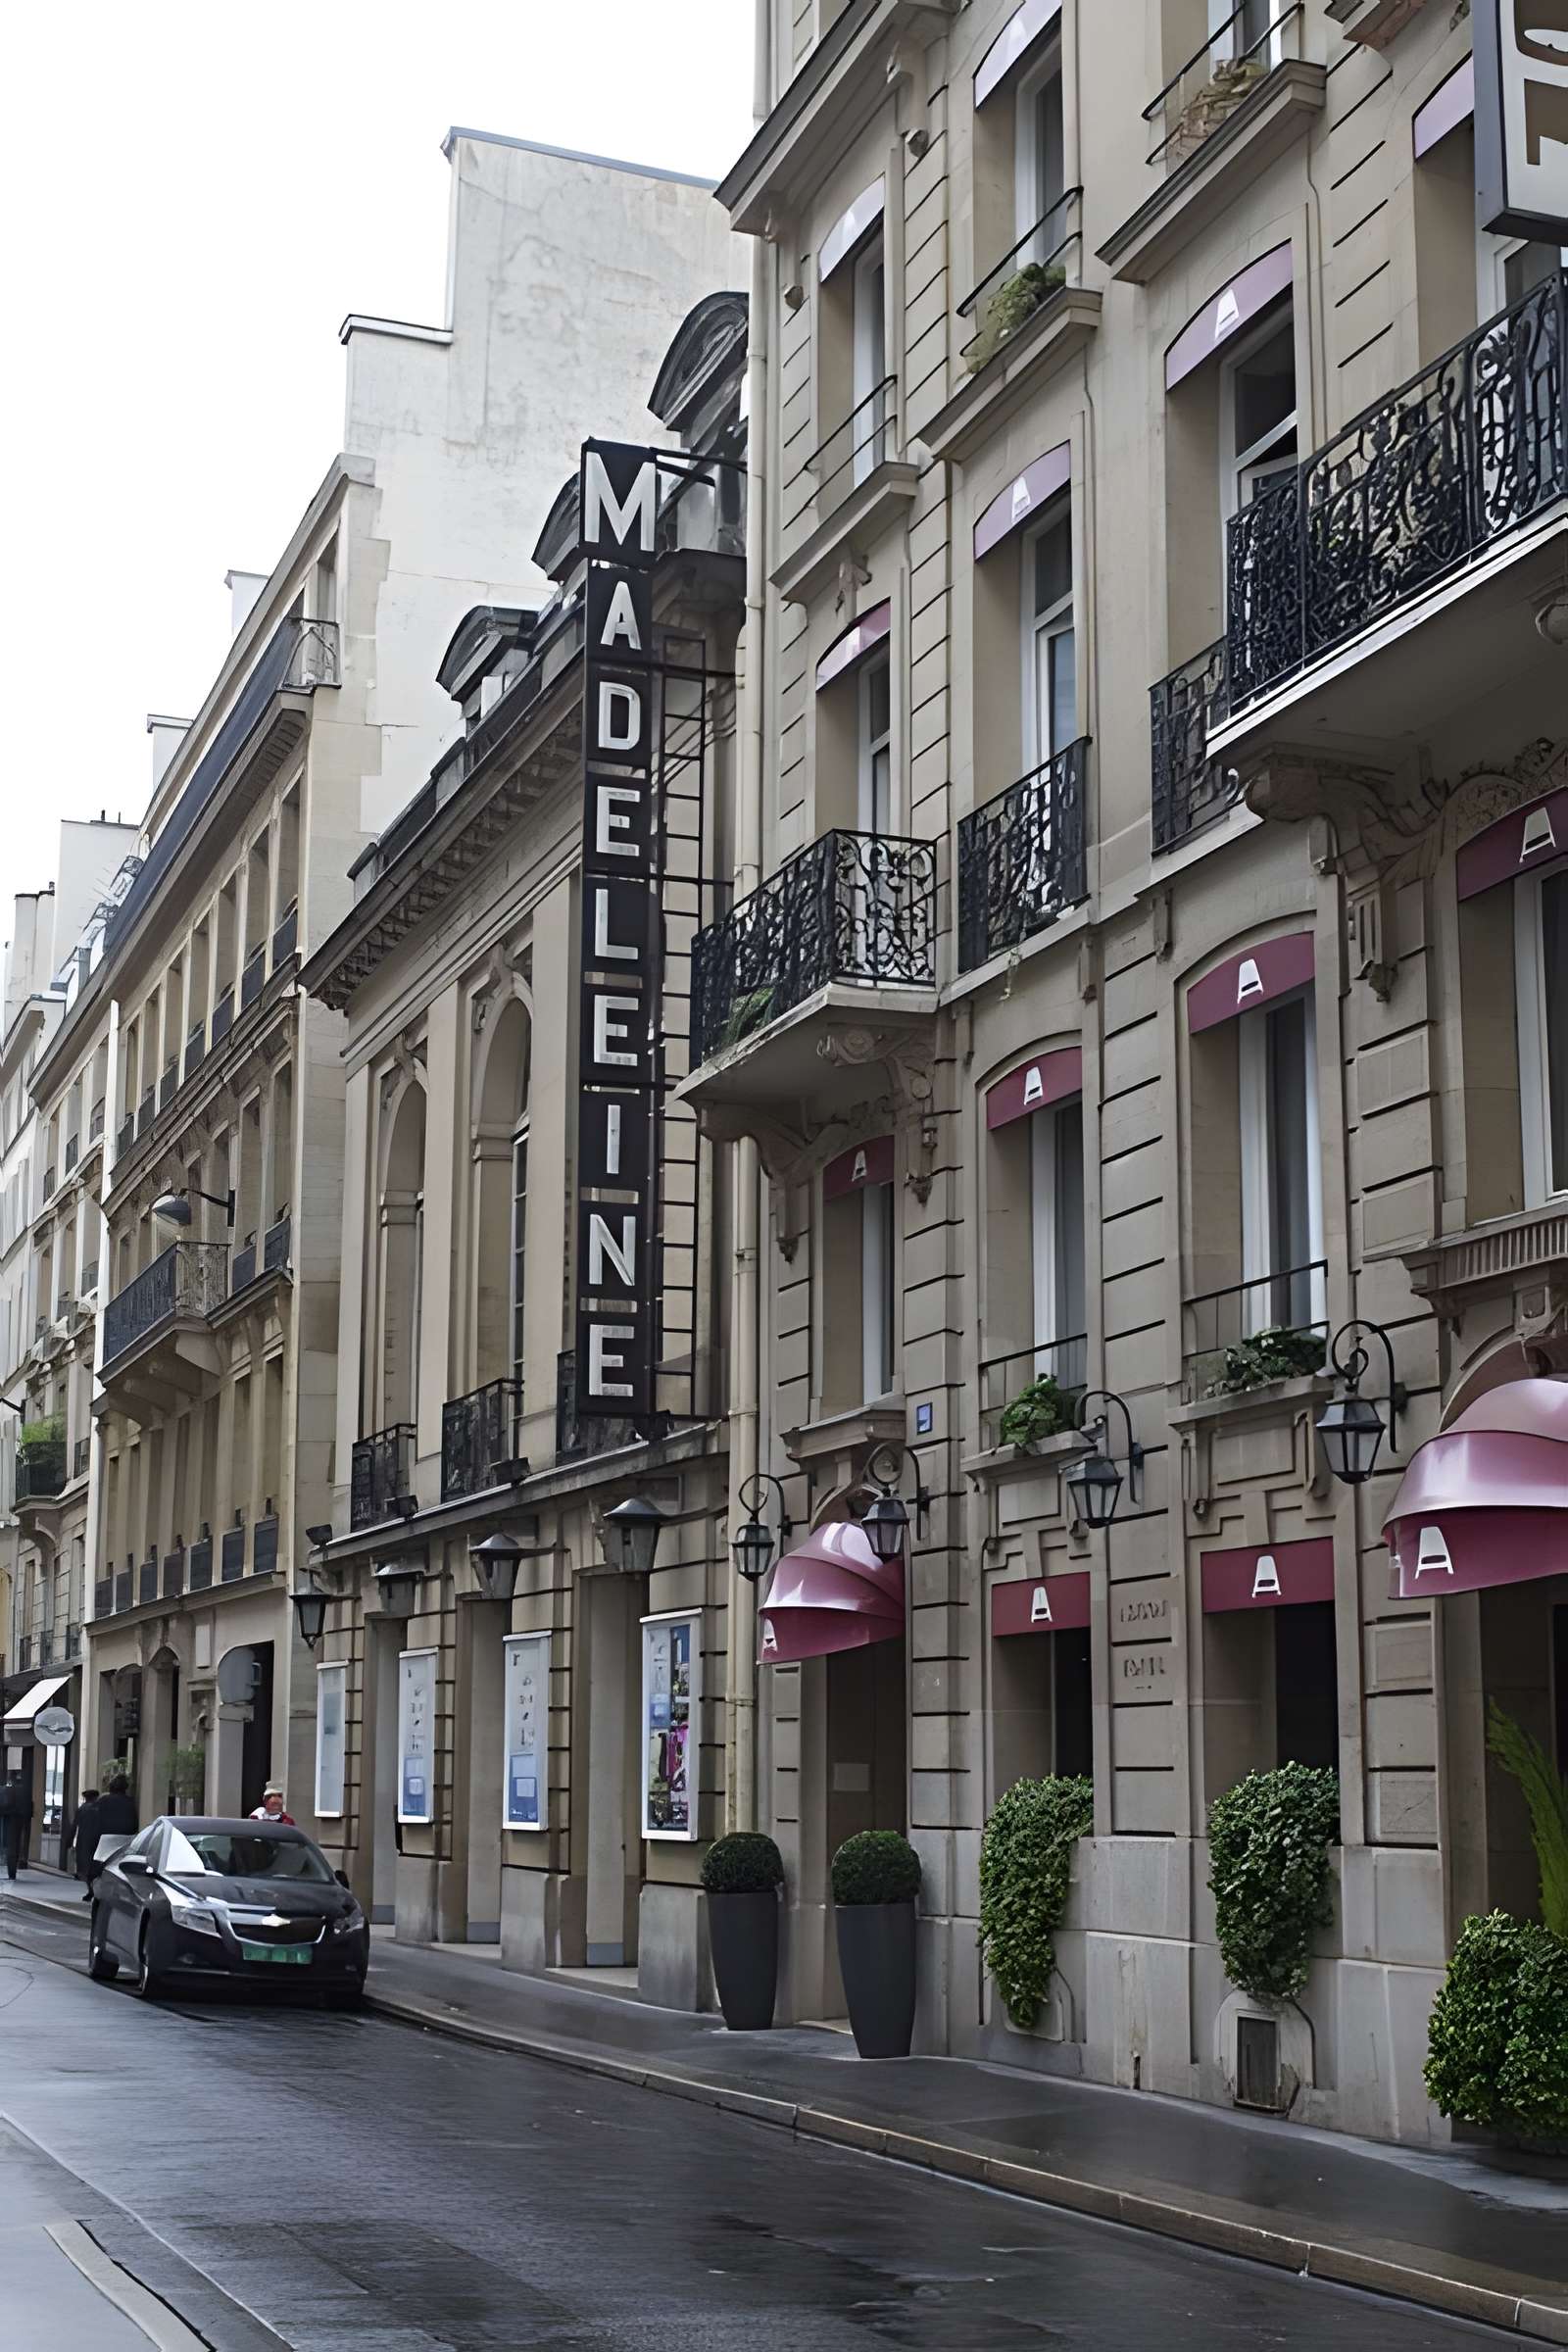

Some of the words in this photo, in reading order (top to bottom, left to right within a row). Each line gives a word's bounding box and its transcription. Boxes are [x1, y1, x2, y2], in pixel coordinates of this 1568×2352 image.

[1519, 807, 1556, 863] A
[584, 451, 657, 1397] MADELEINE
[1237, 958, 1264, 1004] A
[1023, 1066, 1044, 1106] A
[1414, 1526, 1454, 1579] A
[1251, 1555, 1282, 1598] A
[1030, 1587, 1053, 1623] A
